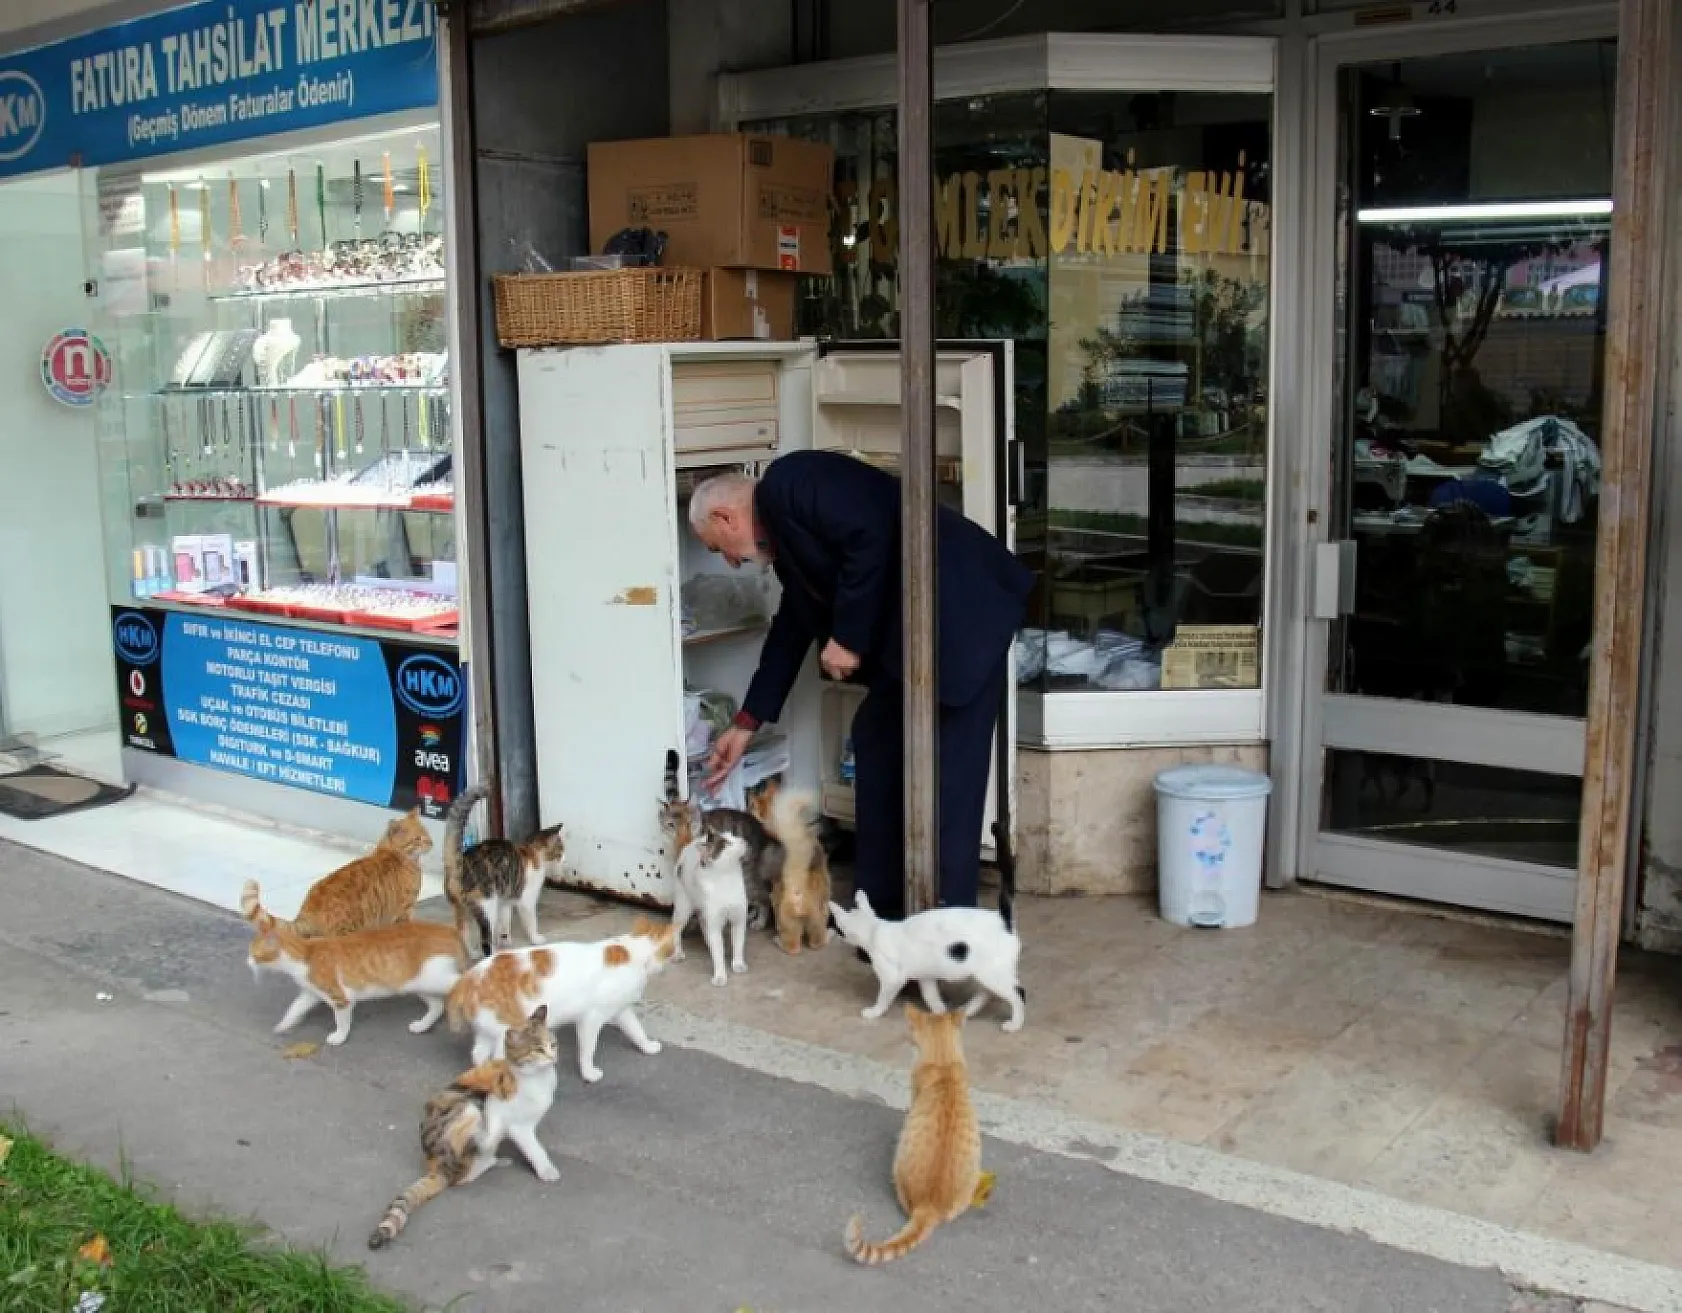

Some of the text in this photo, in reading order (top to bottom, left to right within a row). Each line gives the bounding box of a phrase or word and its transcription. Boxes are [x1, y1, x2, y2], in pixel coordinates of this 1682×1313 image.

[71, 42, 158, 115] FATURA
[162, 5, 288, 94] TAHSİLAT
[128, 69, 355, 148] (Geçmiş Dönem Faturalar Ödenir)
[119, 624, 153, 647] HKM
[259, 633, 273, 647] EL
[275, 635, 296, 651] CEP
[300, 639, 360, 661] TELEFONU
[206, 661, 255, 681] MOTORLU
[405, 669, 454, 698] HKM
[414, 749, 450, 773] avea
